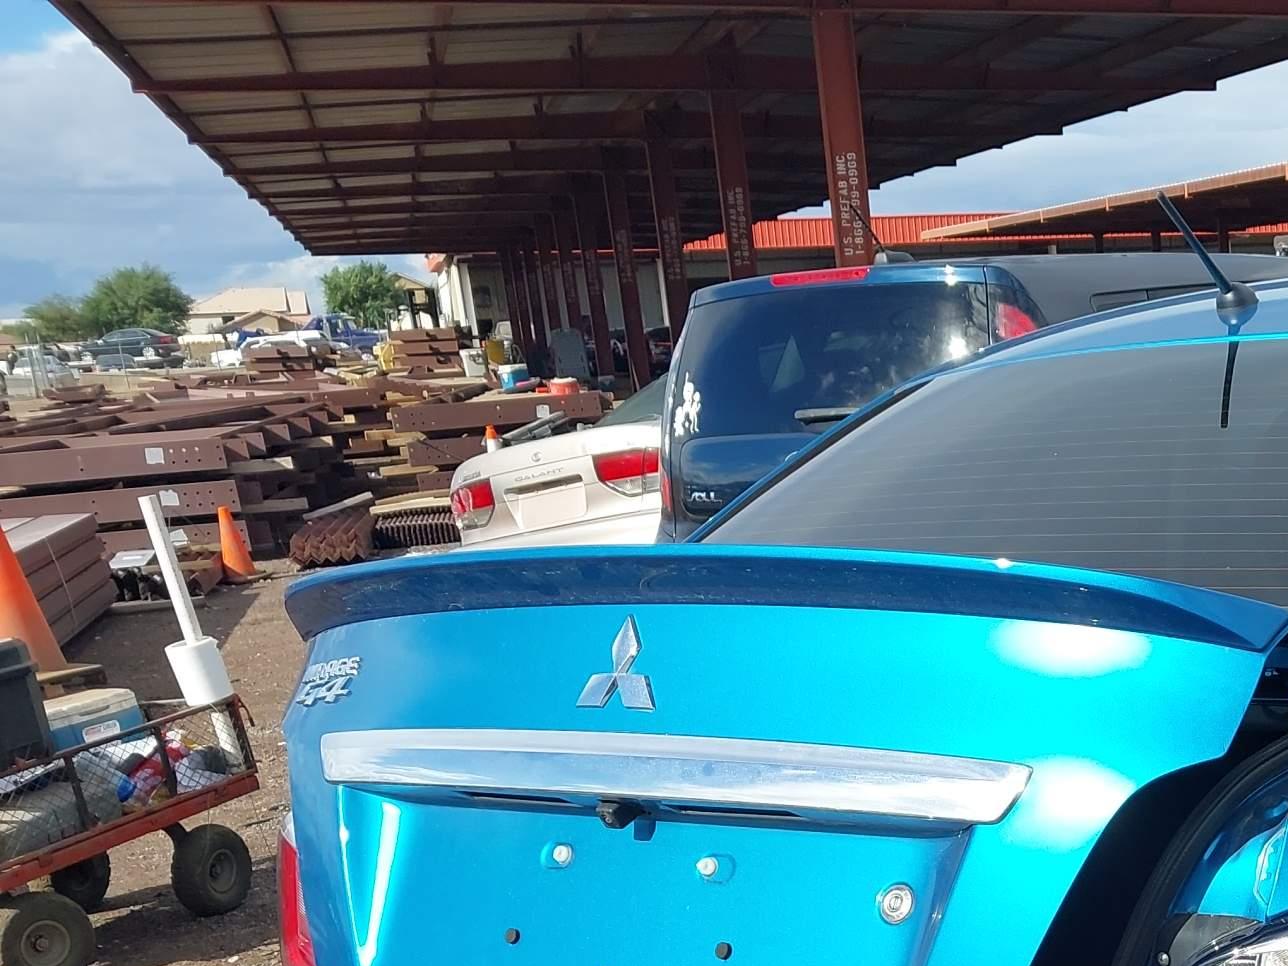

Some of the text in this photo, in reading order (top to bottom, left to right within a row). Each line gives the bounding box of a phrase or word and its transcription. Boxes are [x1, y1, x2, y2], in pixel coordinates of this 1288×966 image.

[835, 152, 854, 256] U.S. PREFAB INC.
[296, 675, 353, 707] G4
